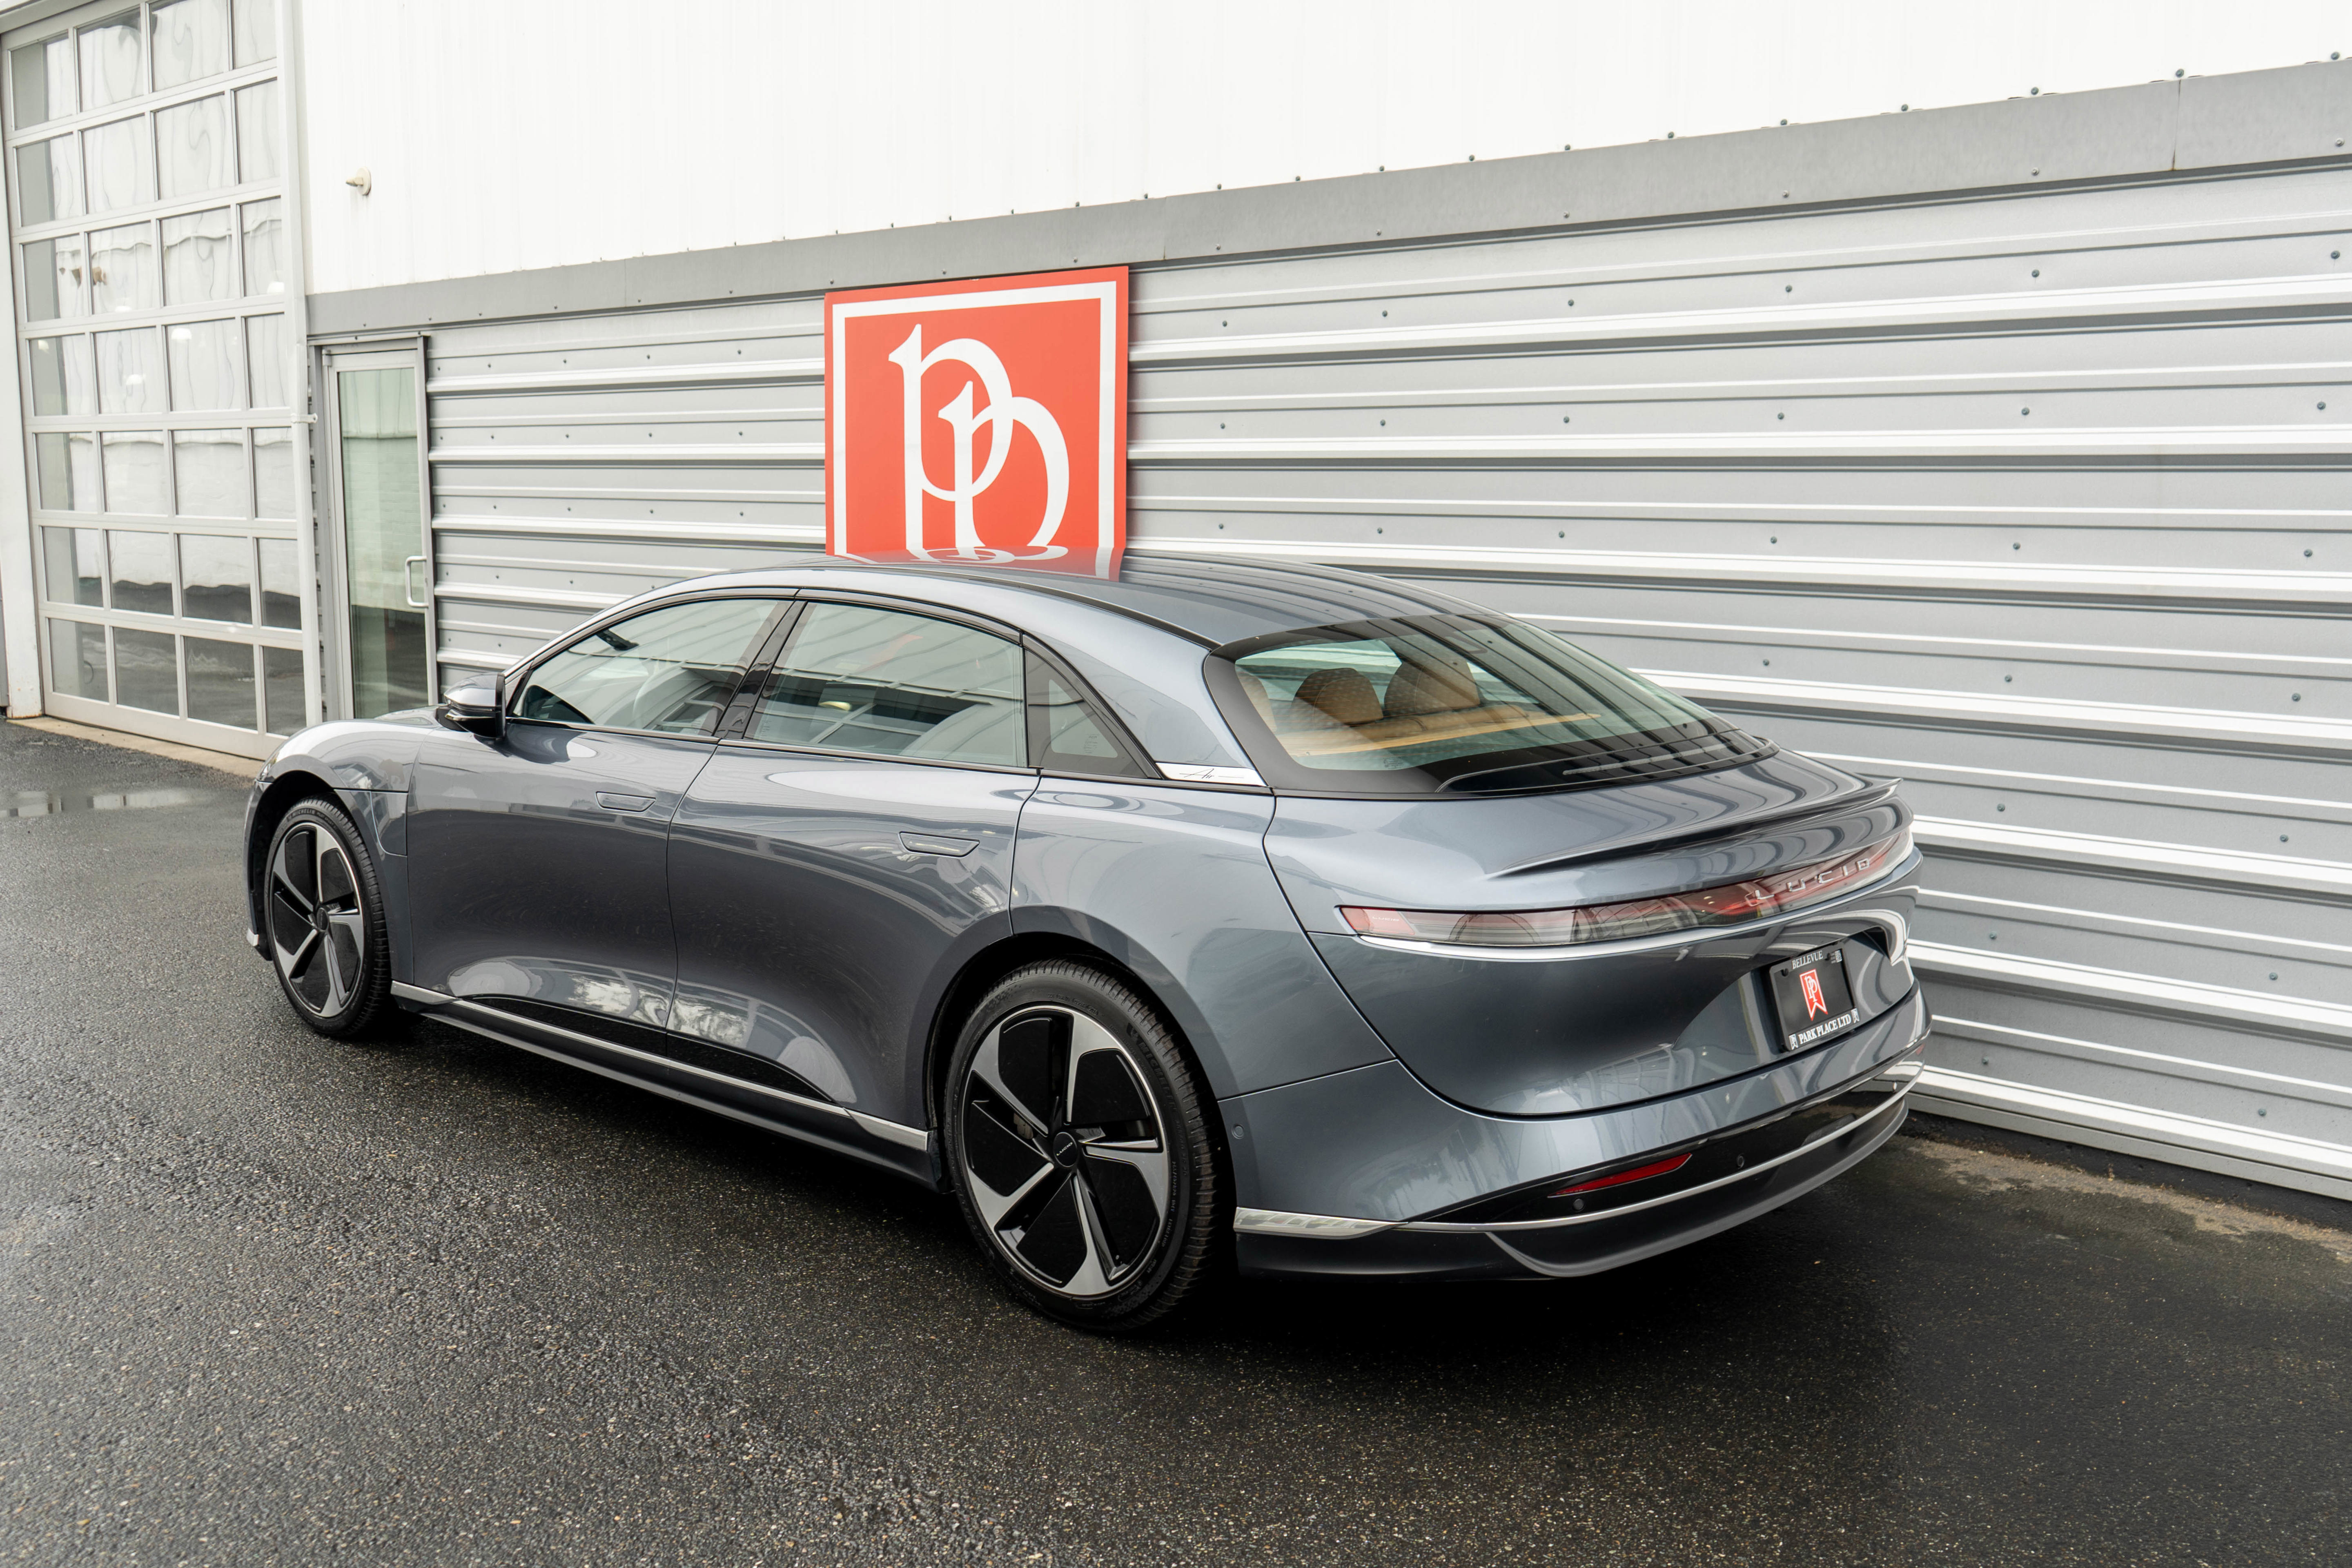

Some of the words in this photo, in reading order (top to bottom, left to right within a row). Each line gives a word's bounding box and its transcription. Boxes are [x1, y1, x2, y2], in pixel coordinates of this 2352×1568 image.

[292, 808, 316, 817] MICHELIN
[1755, 858, 1870, 900] LUCID
[1792, 950, 1823, 969] BELLEVUE
[1798, 1029, 1817, 1045] PARK
[1816, 1020, 1838, 1037] PLACE
[1837, 1014, 1851, 1028] LTD
[1056, 1142, 1073, 1156] LUCID
